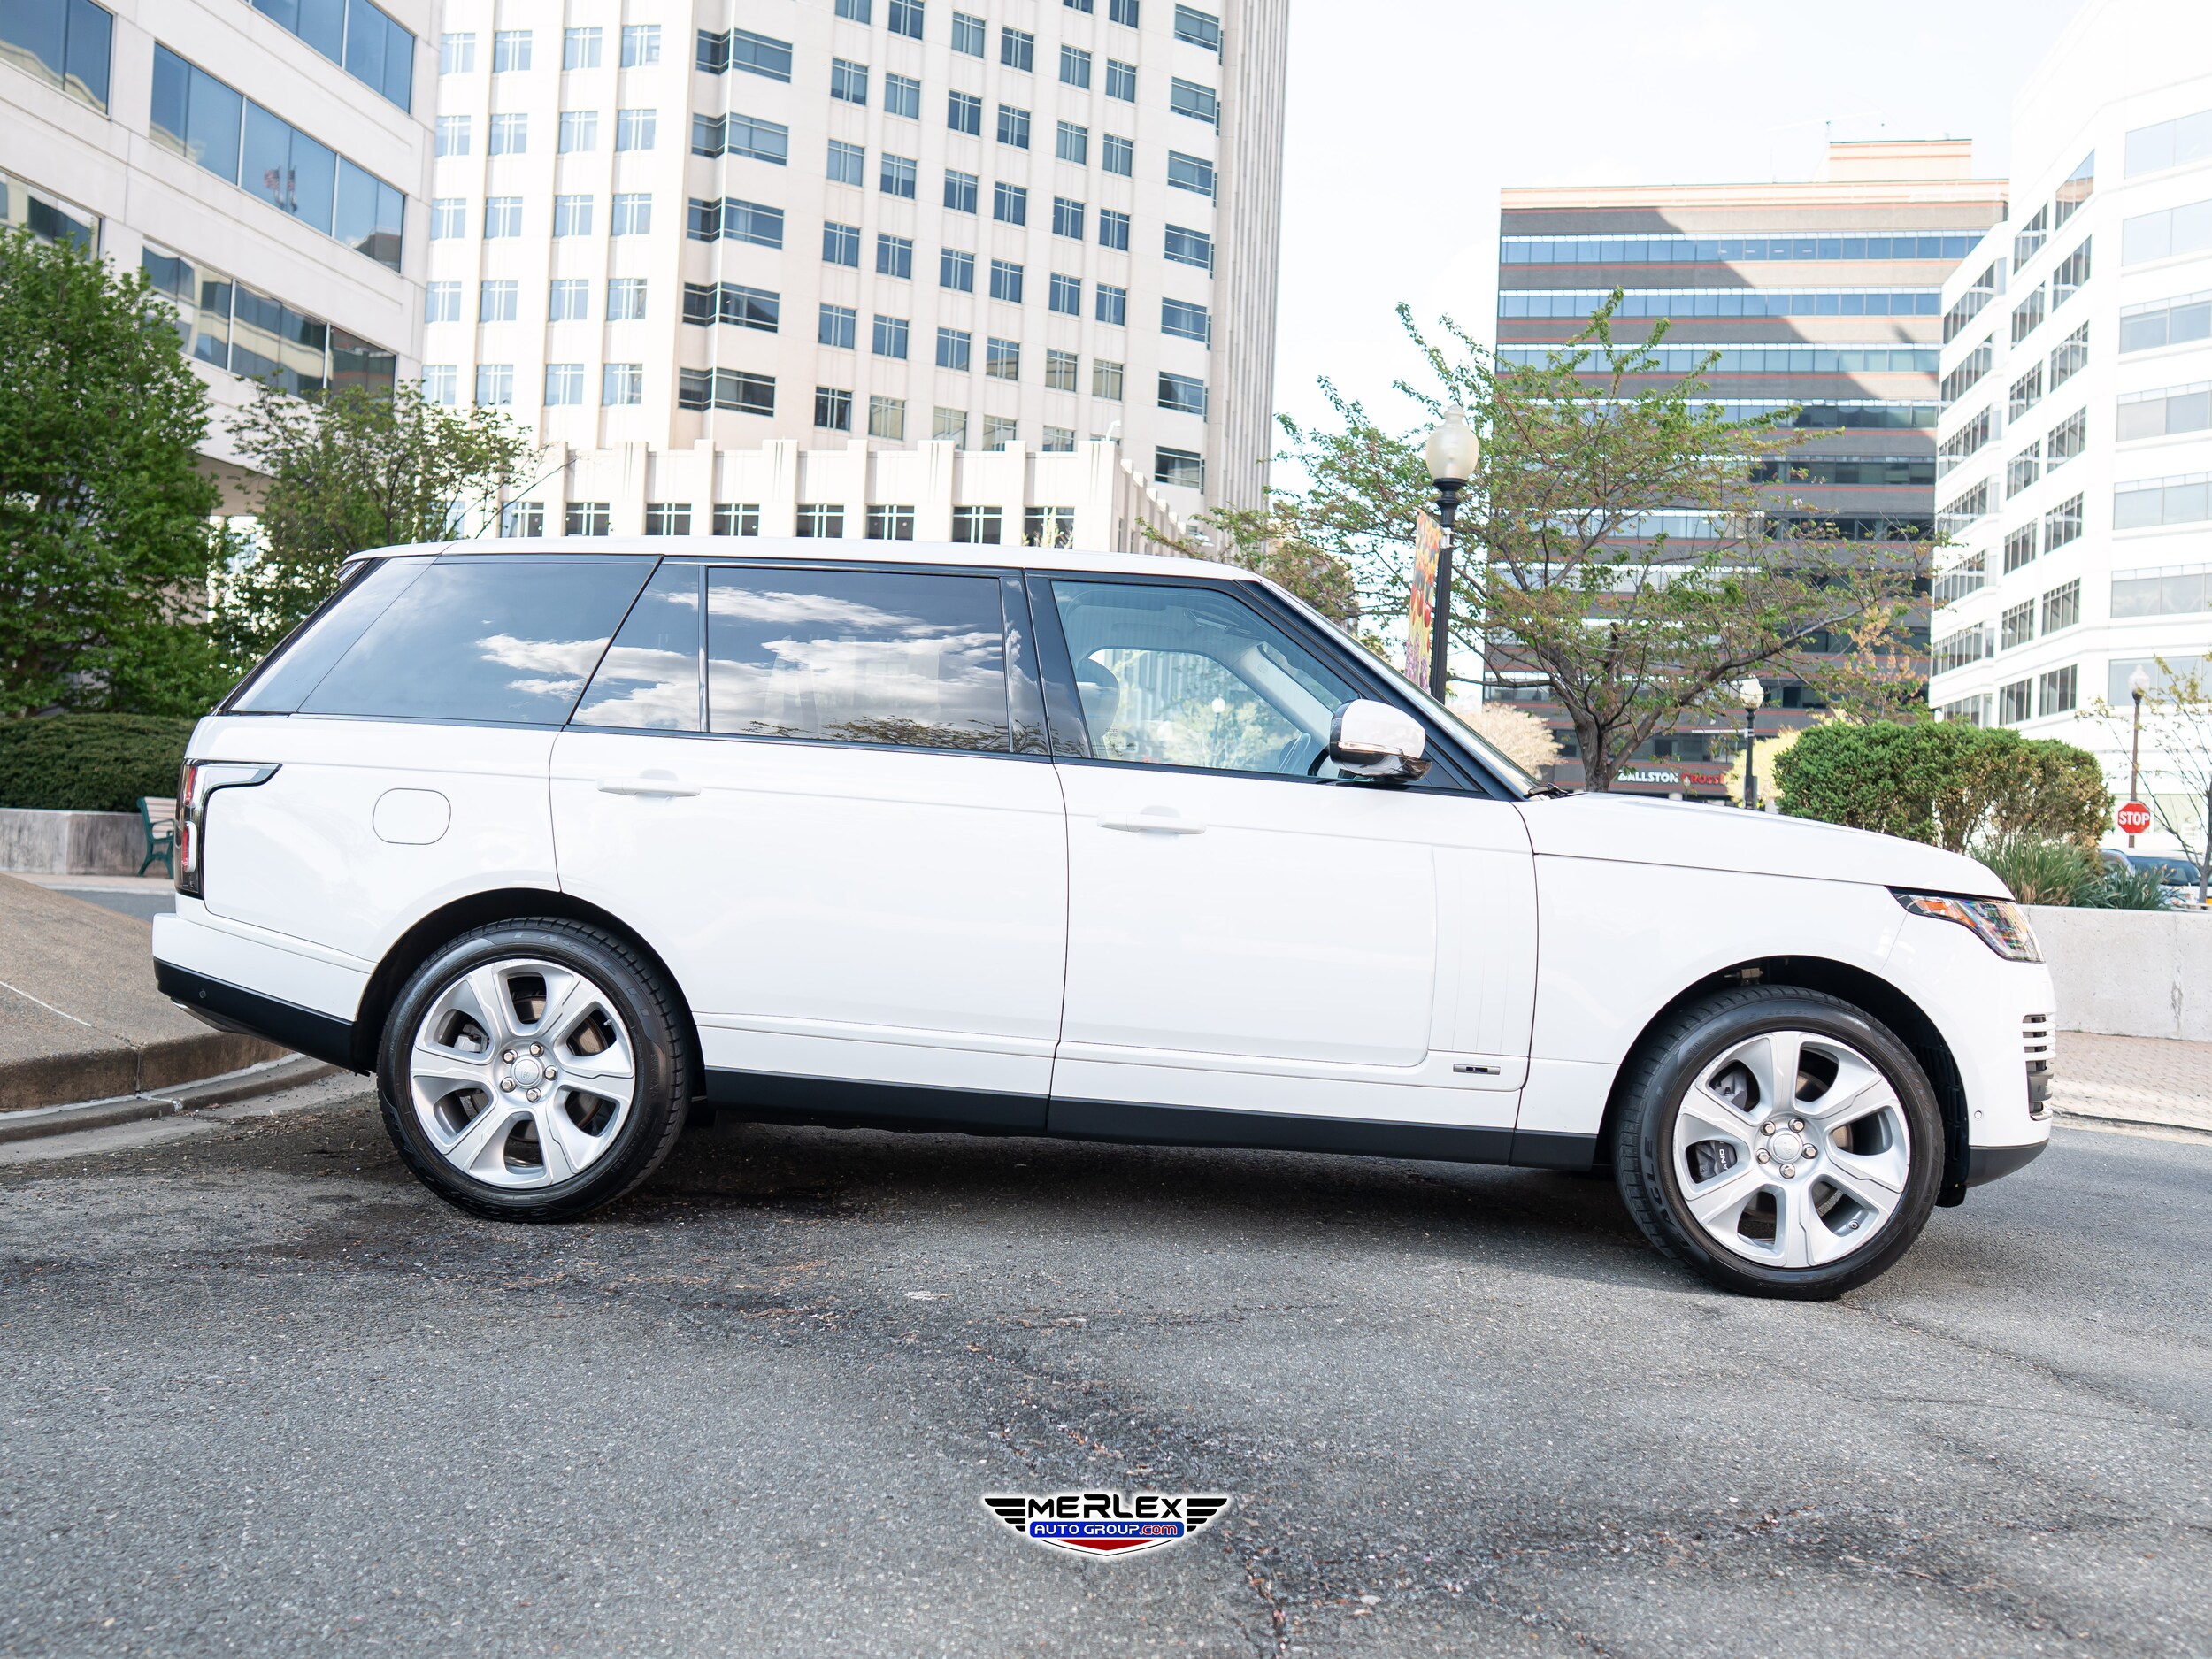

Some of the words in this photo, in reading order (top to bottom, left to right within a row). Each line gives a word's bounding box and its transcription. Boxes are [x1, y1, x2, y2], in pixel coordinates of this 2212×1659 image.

[1617, 769, 1678, 783] BALLSTON
[2118, 811, 2150, 826] STOP
[1645, 1136, 1691, 1250] EAGLE
